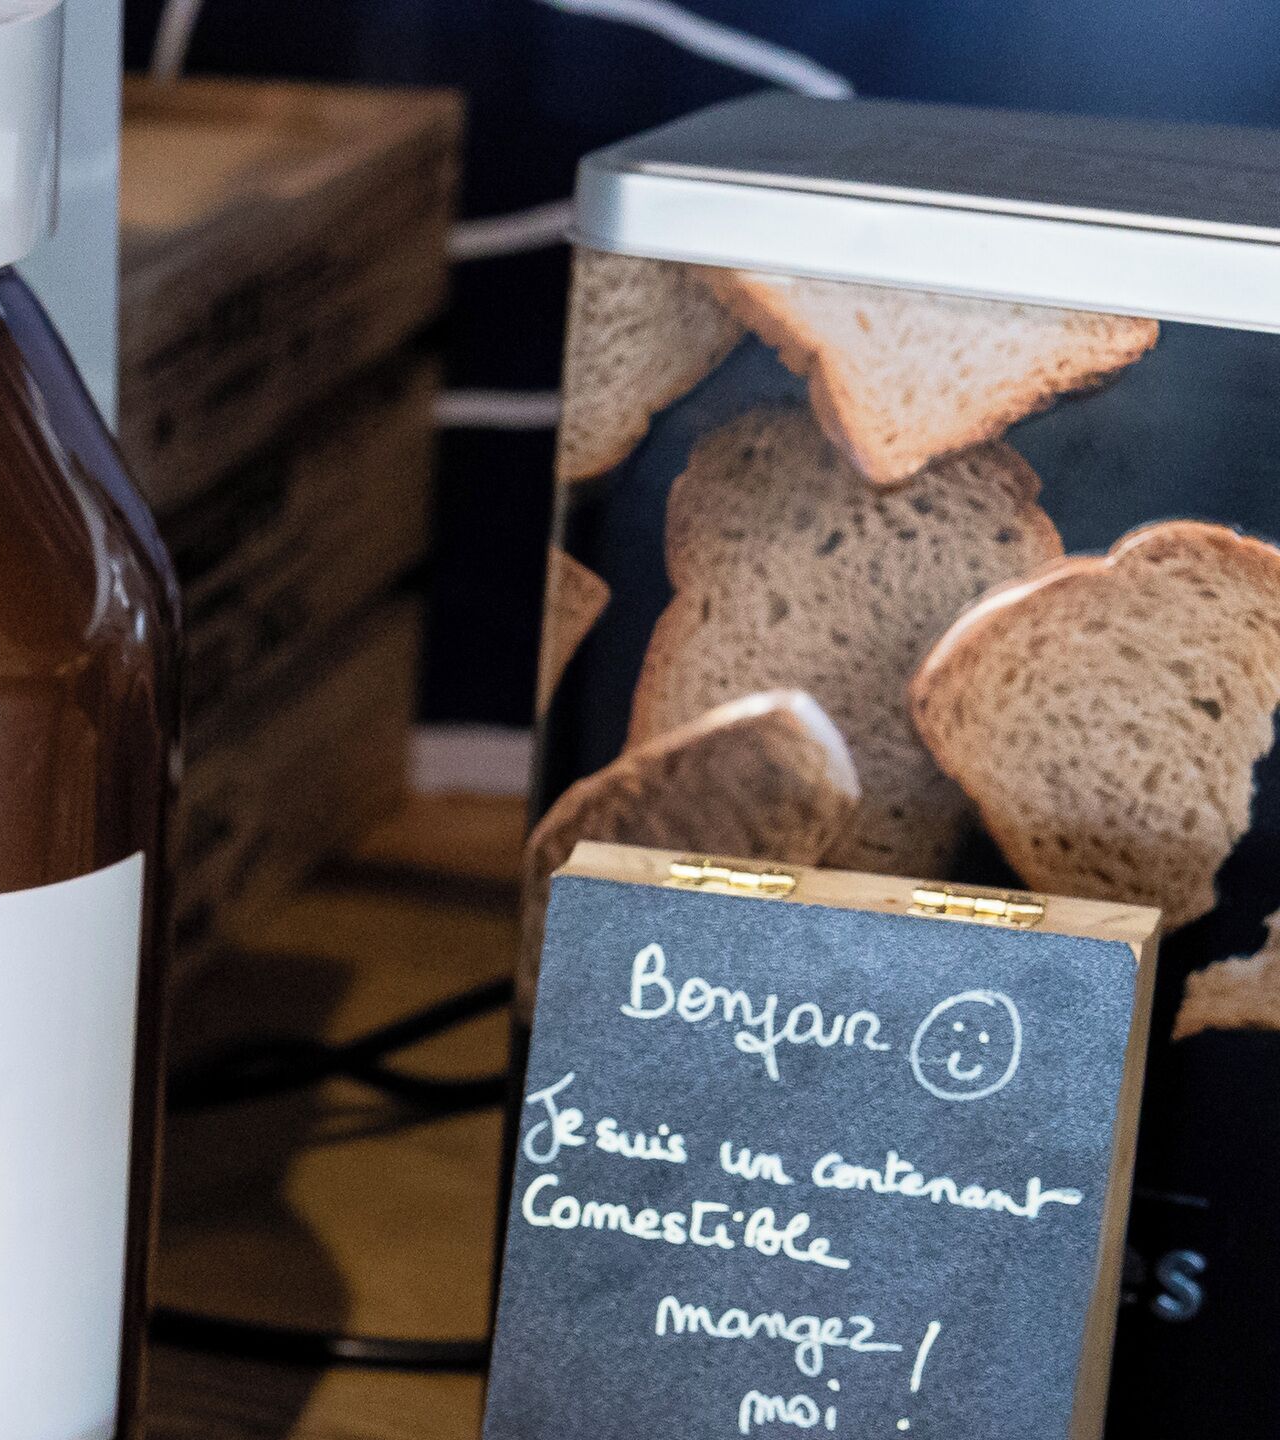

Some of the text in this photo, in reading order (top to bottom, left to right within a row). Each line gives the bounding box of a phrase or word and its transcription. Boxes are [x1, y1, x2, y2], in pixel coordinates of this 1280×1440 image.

[523, 1072, 1083, 1219] Je suis un contenant
[521, 1173, 851, 1270] Comestible
[738, 1377, 842, 1436] moi
